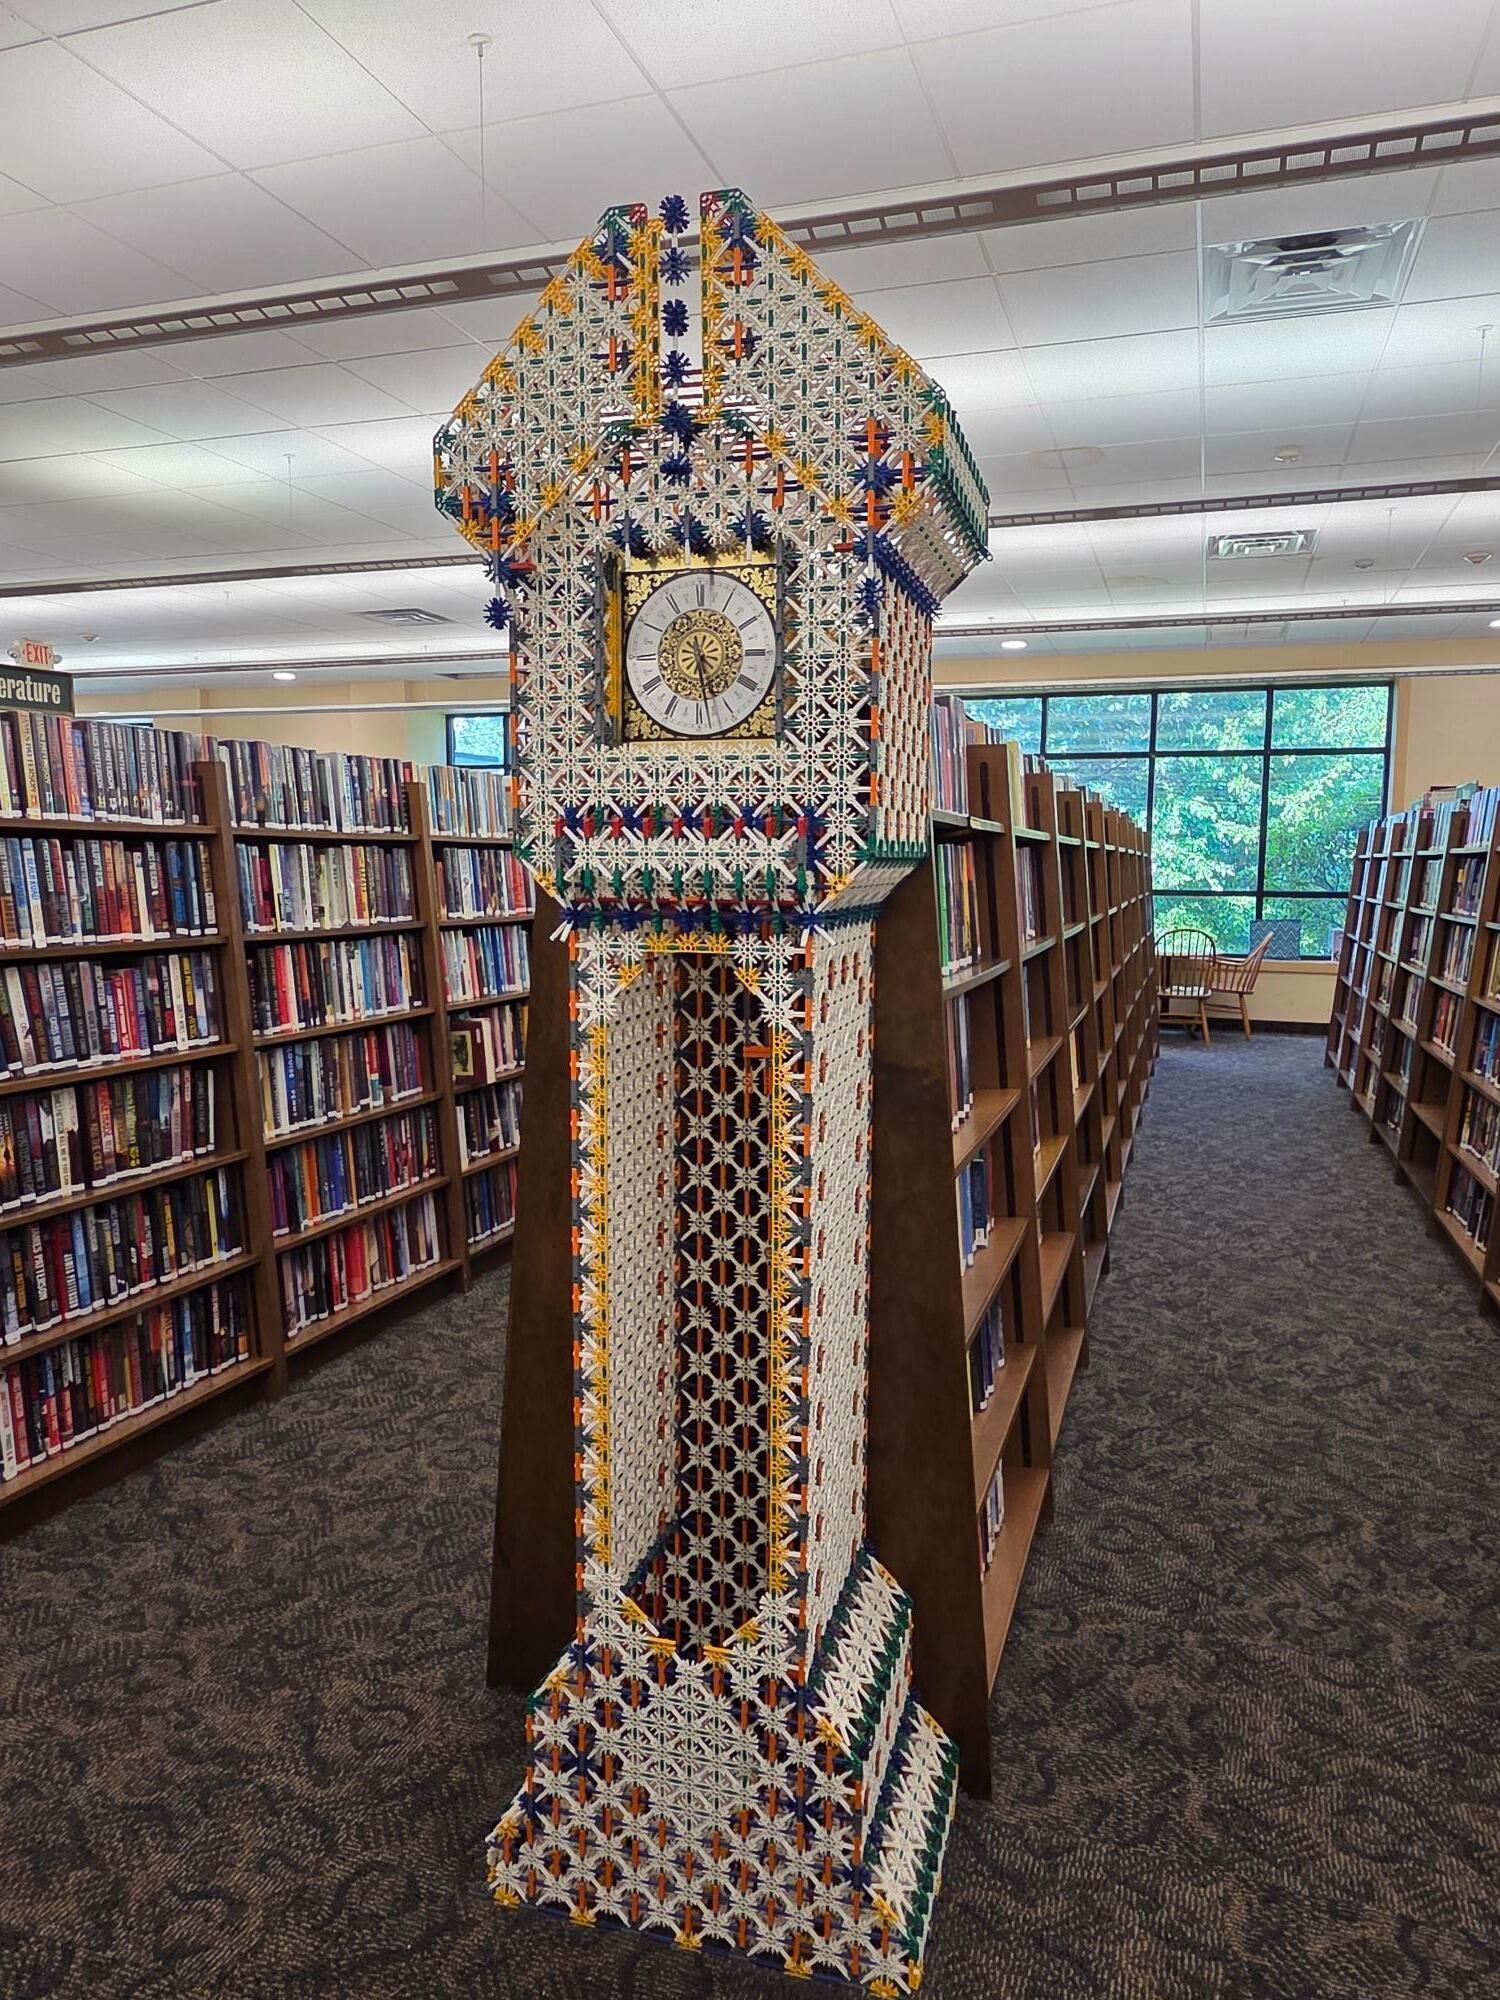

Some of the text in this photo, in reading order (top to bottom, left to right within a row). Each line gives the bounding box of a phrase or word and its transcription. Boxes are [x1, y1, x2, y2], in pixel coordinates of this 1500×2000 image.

[26, 643, 49, 665] EXIT
[91, 725, 99, 746] JAMES
[101, 726, 110, 748] JAMES
[25, 743, 36, 792] PATTERSON
[93, 748, 104, 788] PATTERSON
[105, 750, 114, 789] PATTERSON
[119, 751, 127, 790] PATTERSON
[137, 729, 149, 791] JAMES PATTERSON
[150, 753, 158, 788] PATTERSON
[26, 857, 36, 880] BEACH
[148, 863, 158, 889] PATTERSON
[56, 987, 69, 1017] PATTERSON
[49, 1017, 60, 1035] CROSS
[109, 1014, 117, 1043] PATTERSON
[53, 1036, 61, 1046] THE
[55, 1046, 64, 1058] LINE
[286, 1048, 294, 1078] LOUISE
[126, 1105, 137, 1144] Patterson
[61, 1148, 68, 1156] ME
[92, 1139, 101, 1151] THE
[30, 1227, 47, 1300] JAMES PATTERSON
[64, 1254, 78, 1309] JAMES PATTERSON
